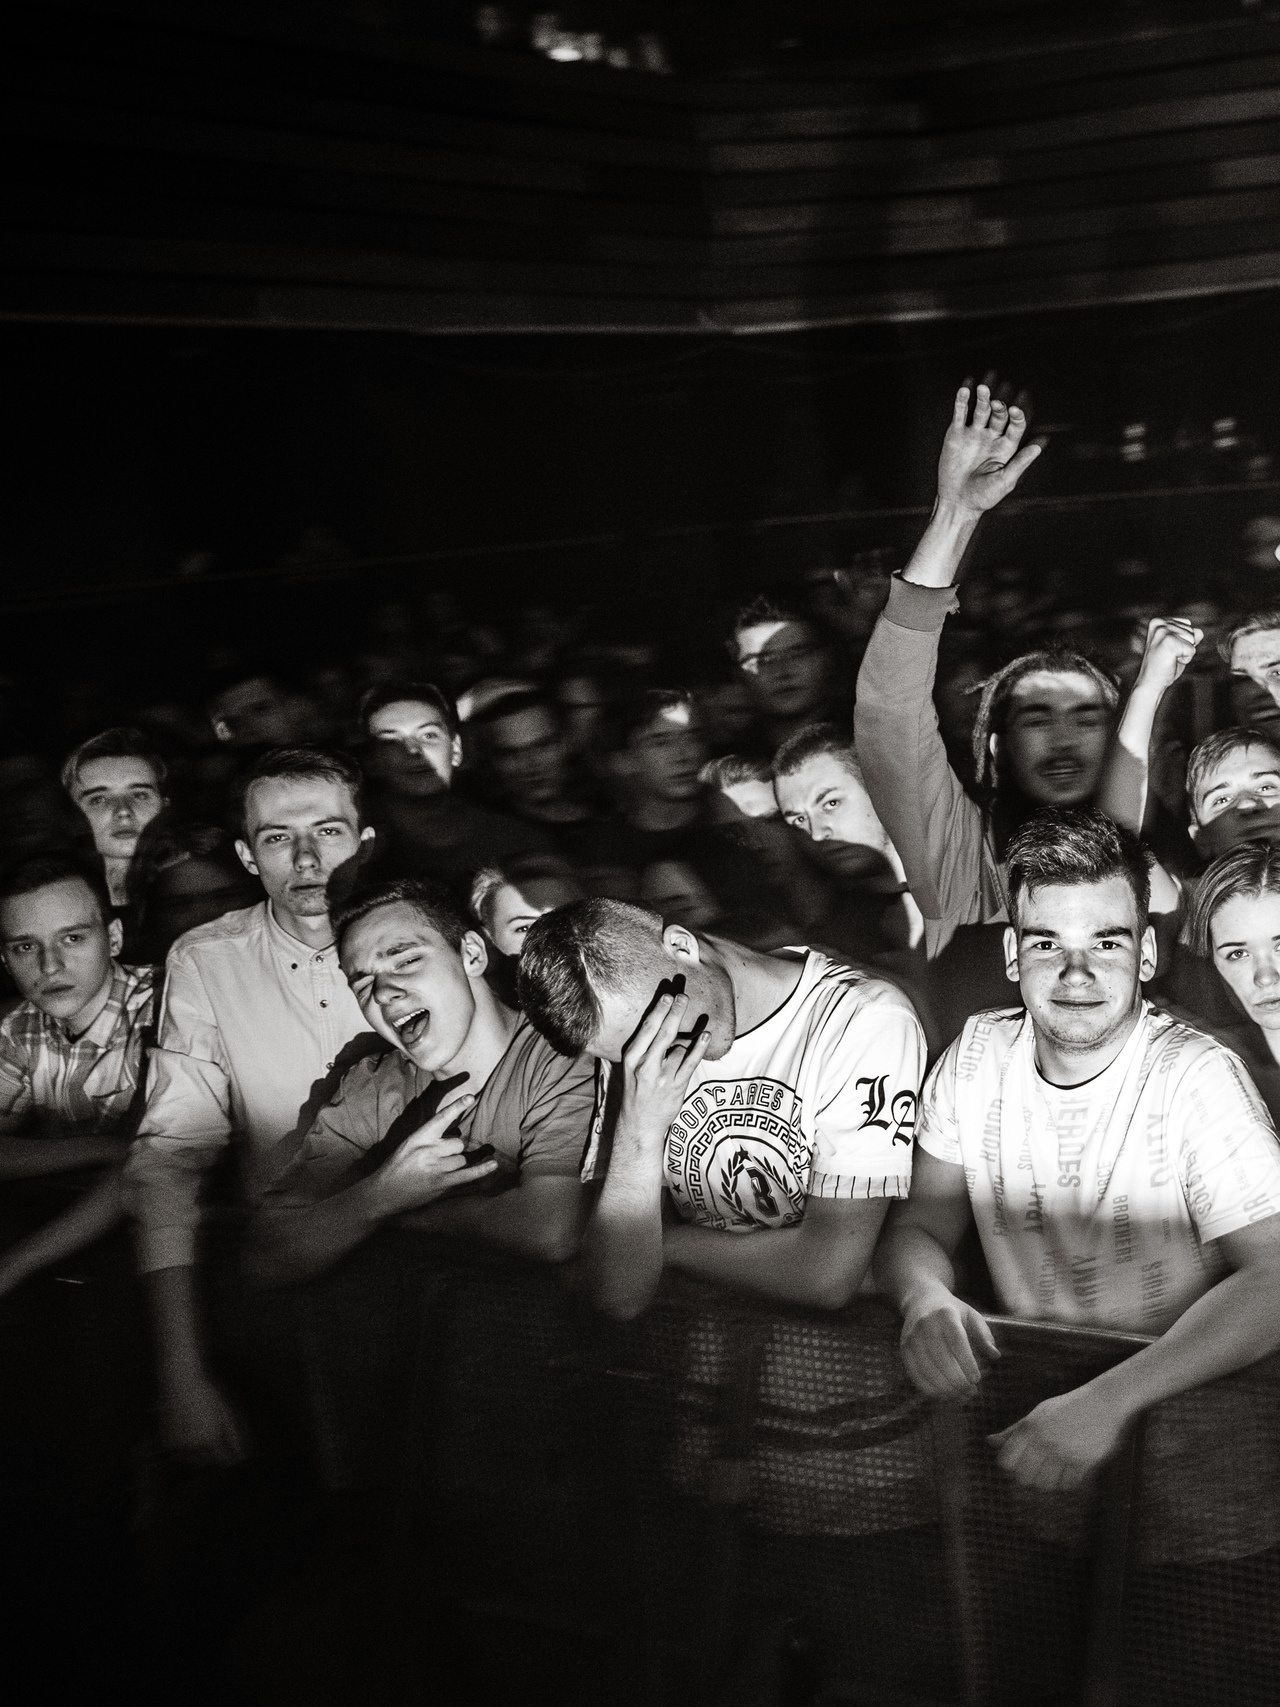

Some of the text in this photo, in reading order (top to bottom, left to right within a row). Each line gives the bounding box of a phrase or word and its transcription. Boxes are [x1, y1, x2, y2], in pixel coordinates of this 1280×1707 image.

[713, 1083, 784, 1111] CARES
[1056, 1092, 1091, 1188] HEROES
[1146, 1111, 1175, 1188] DUTY
[1112, 1194, 1134, 1265] BROTHERS
